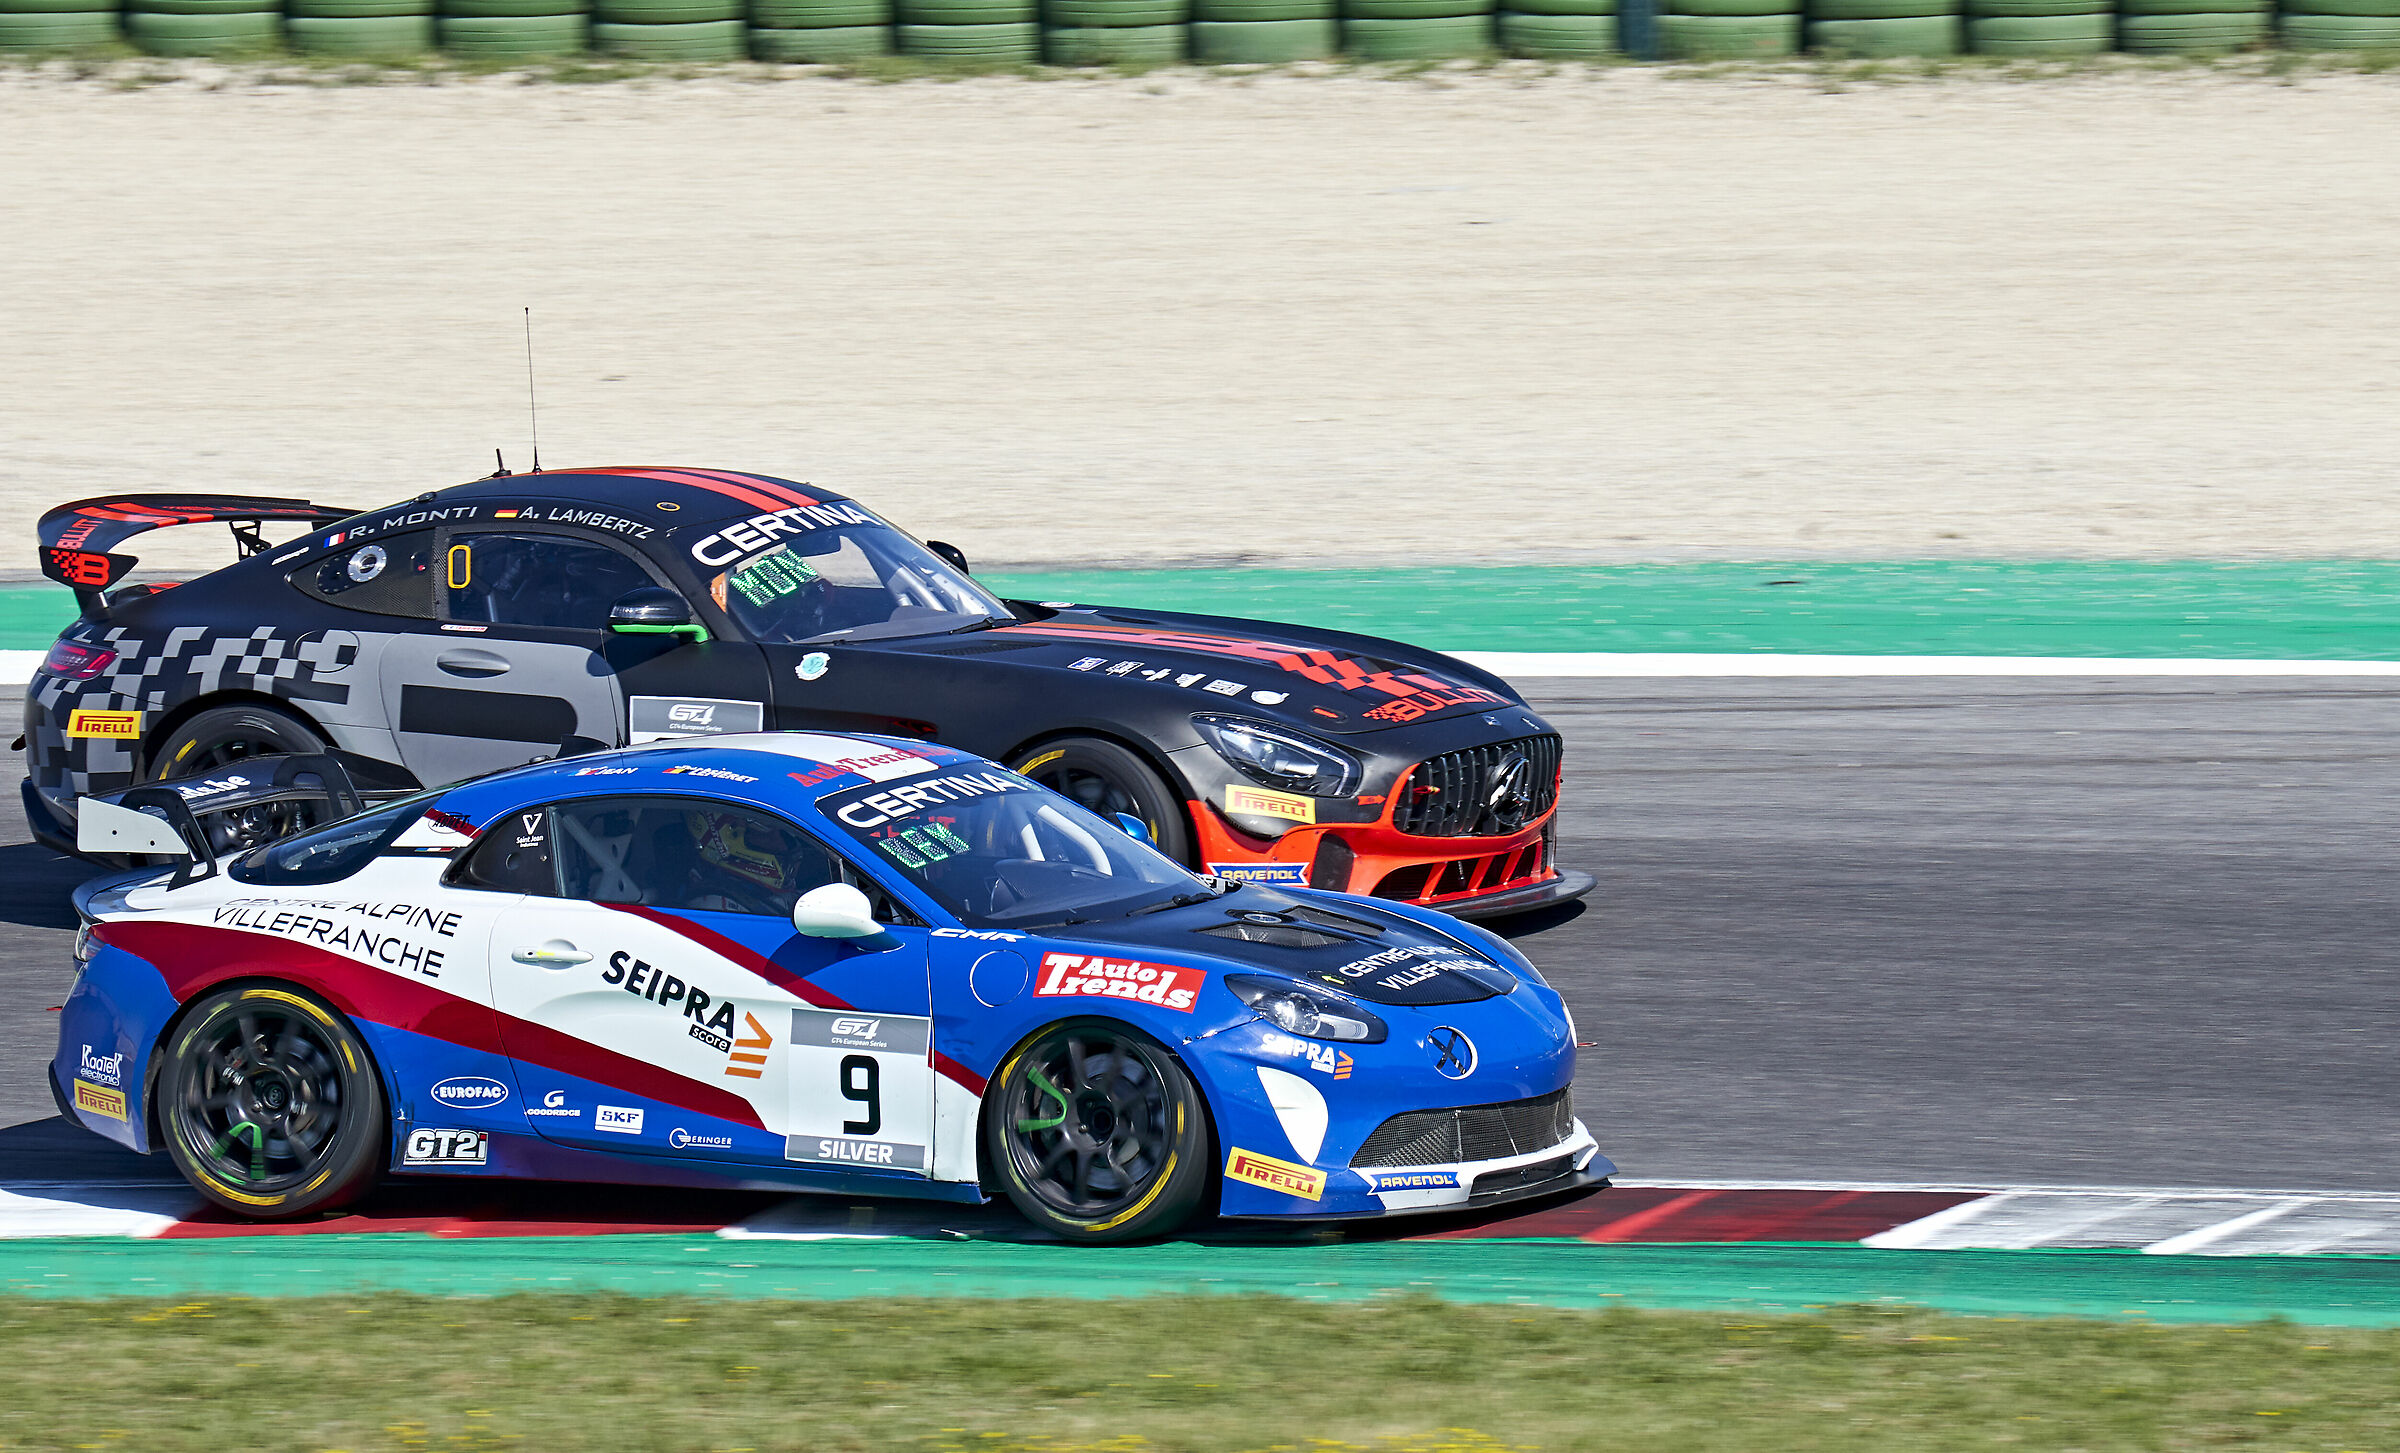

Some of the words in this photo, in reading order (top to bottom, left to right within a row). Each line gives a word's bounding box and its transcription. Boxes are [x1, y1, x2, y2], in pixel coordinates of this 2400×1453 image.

[349, 525, 375, 540] R.
[382, 506, 478, 530] MONTI
[520, 506, 541, 520] A.
[548, 507, 656, 540] LAMBERTZ
[691, 504, 882, 567] CERTINA
[76, 715, 134, 733] PIRELLI
[668, 704, 716, 725] GT4
[837, 772, 1028, 828] CERTINA
[1233, 791, 1307, 817] PIRELLI
[1220, 869, 1298, 881] RAVENOL
[345, 902, 463, 938] ALPINE
[213, 907, 445, 979] VILLEFRANCHE
[930, 927, 1027, 943] CMR
[1079, 957, 1158, 983] Auto
[1338, 947, 1415, 979] CENTRE
[601, 949, 735, 1040] SEIPRA
[1038, 953, 1196, 1010] Trends
[691, 1026, 729, 1051] score
[830, 1017, 881, 1040] GT4
[843, 1038, 870, 1047] European
[869, 1040, 888, 1048] Series
[78, 1086, 122, 1115] PIRELLI
[439, 1086, 502, 1099] EUROFAC
[839, 1054, 882, 1135] 9
[527, 1108, 581, 1117] GOODRIDGE
[601, 1110, 640, 1124] SKF
[406, 1130, 488, 1160] GT2i
[817, 1137, 894, 1165] SILVER
[1235, 1155, 1317, 1195] PIRELLI
[1380, 1174, 1454, 1188] RAVENOL
